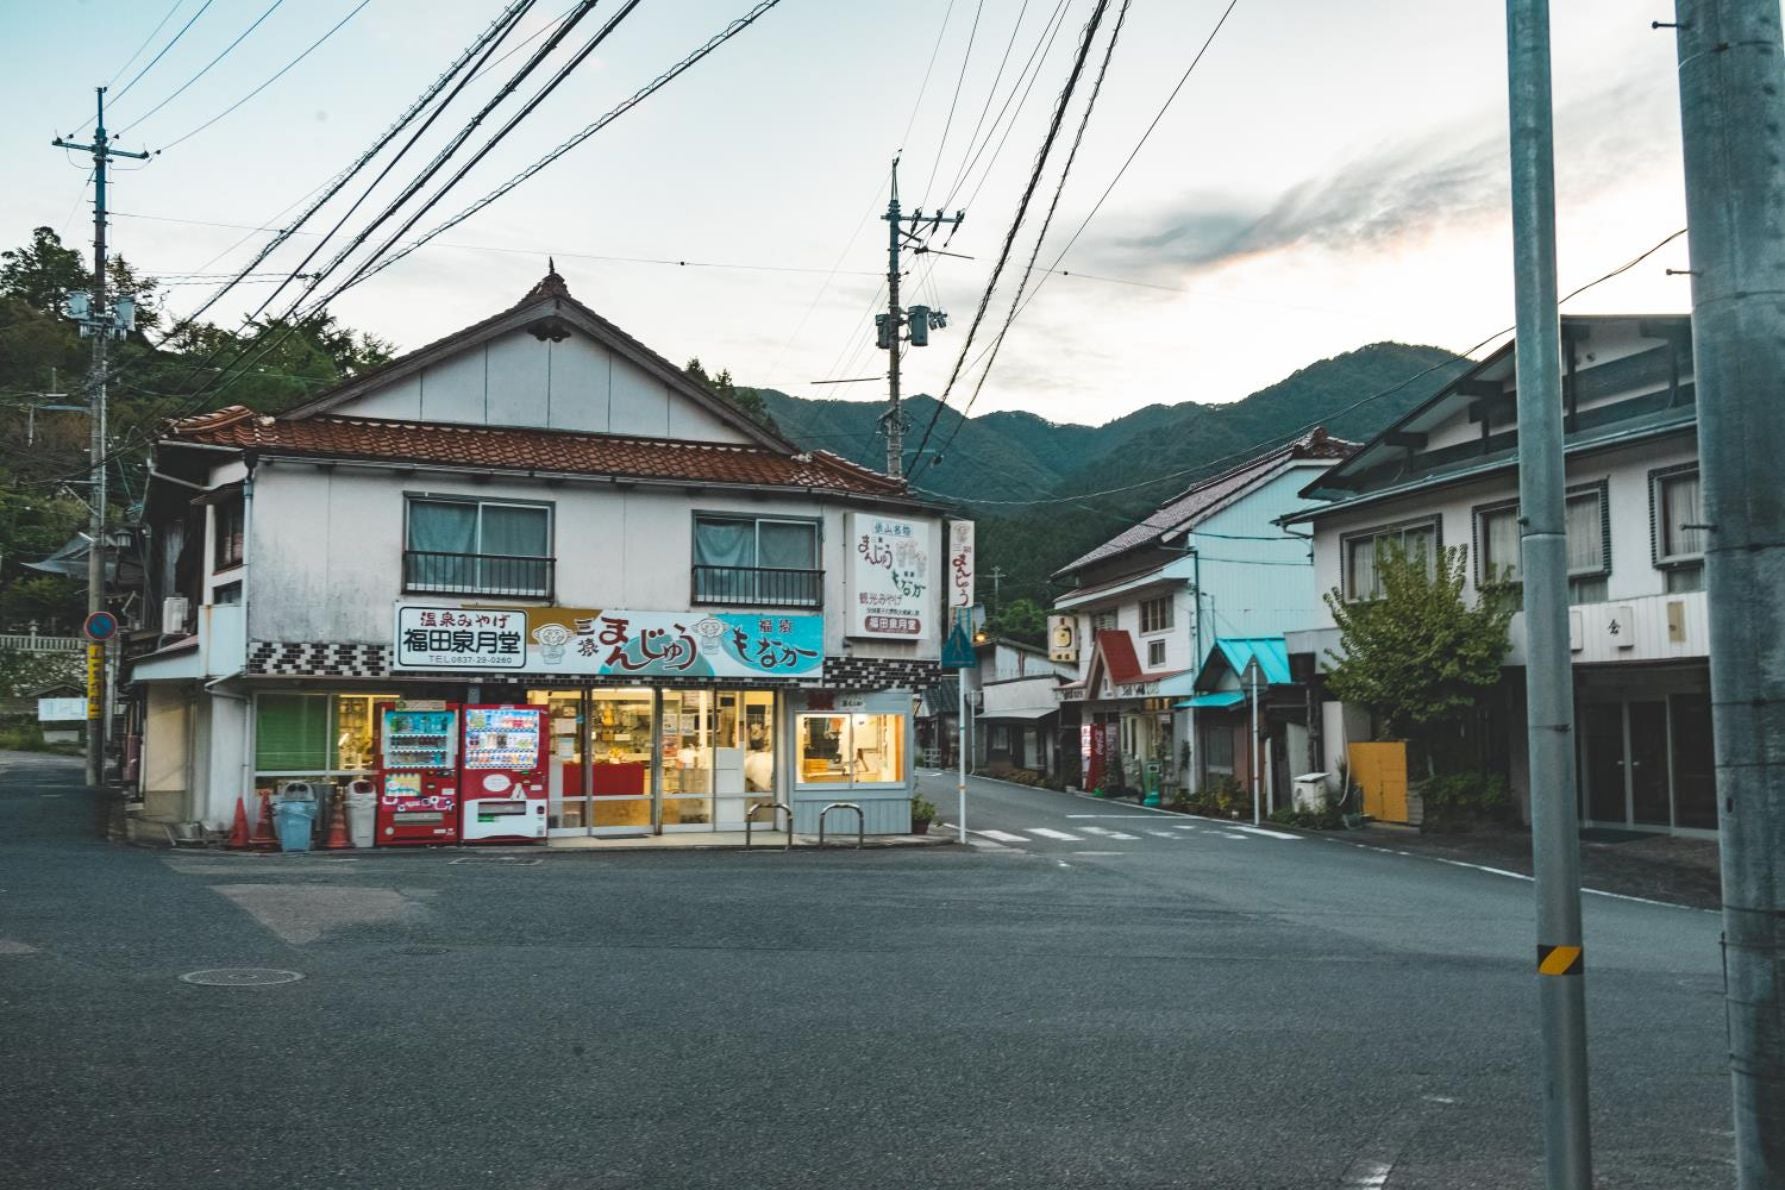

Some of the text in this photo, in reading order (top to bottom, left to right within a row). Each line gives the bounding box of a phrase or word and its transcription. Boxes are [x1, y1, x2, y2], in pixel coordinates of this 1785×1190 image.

[891, 568, 926, 598] もなか
[952, 554, 972, 607] まんじゅう
[420, 612, 511, 629] 温泉みやげ
[403, 628, 521, 654] 福田泉月堂
[599, 616, 697, 670] まんじゅう
[732, 626, 818, 667] もなか
